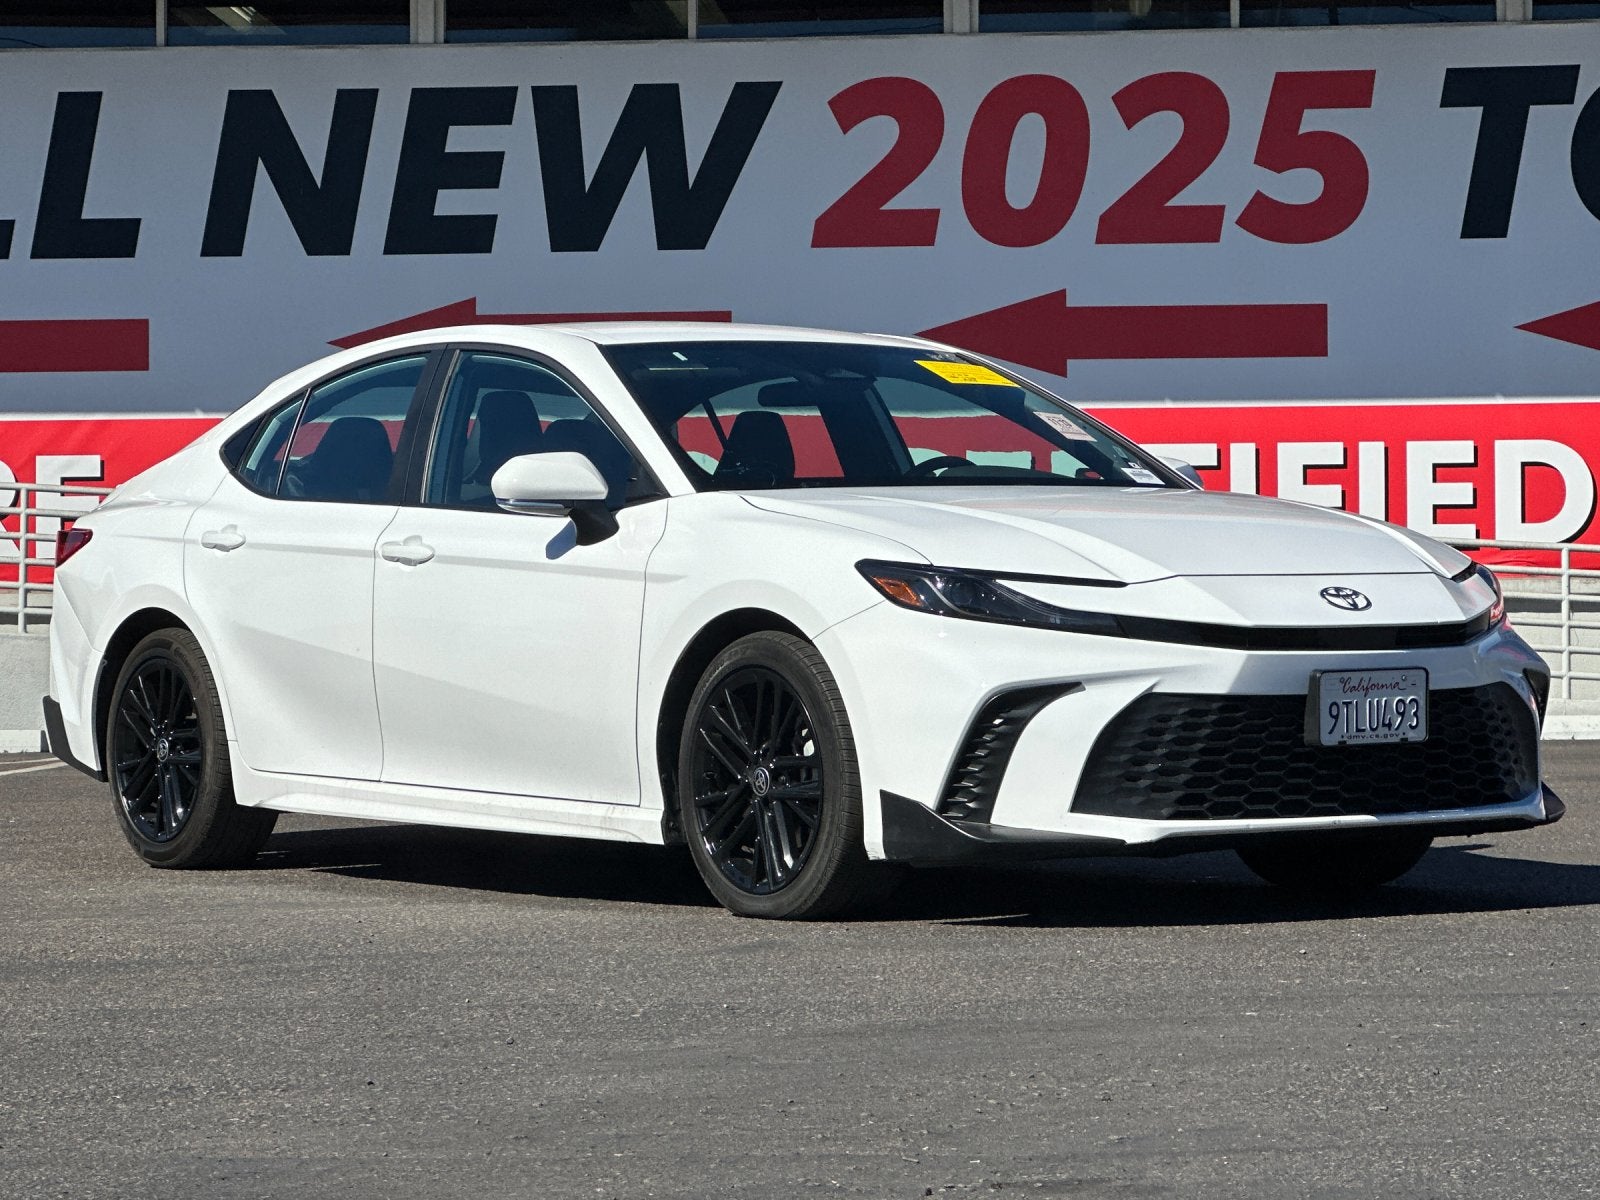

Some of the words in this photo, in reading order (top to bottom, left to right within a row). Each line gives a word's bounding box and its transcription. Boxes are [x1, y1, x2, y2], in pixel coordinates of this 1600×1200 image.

[0, 91, 141, 259] L
[200, 81, 783, 257] NEW
[811, 70, 1375, 248] 2025
[1439, 64, 1600, 239] T
[0, 455, 102, 560] E
[1137, 439, 1594, 544] IFIED
[1328, 696, 1419, 735] 9TLU493
[1343, 676, 1406, 698] California
